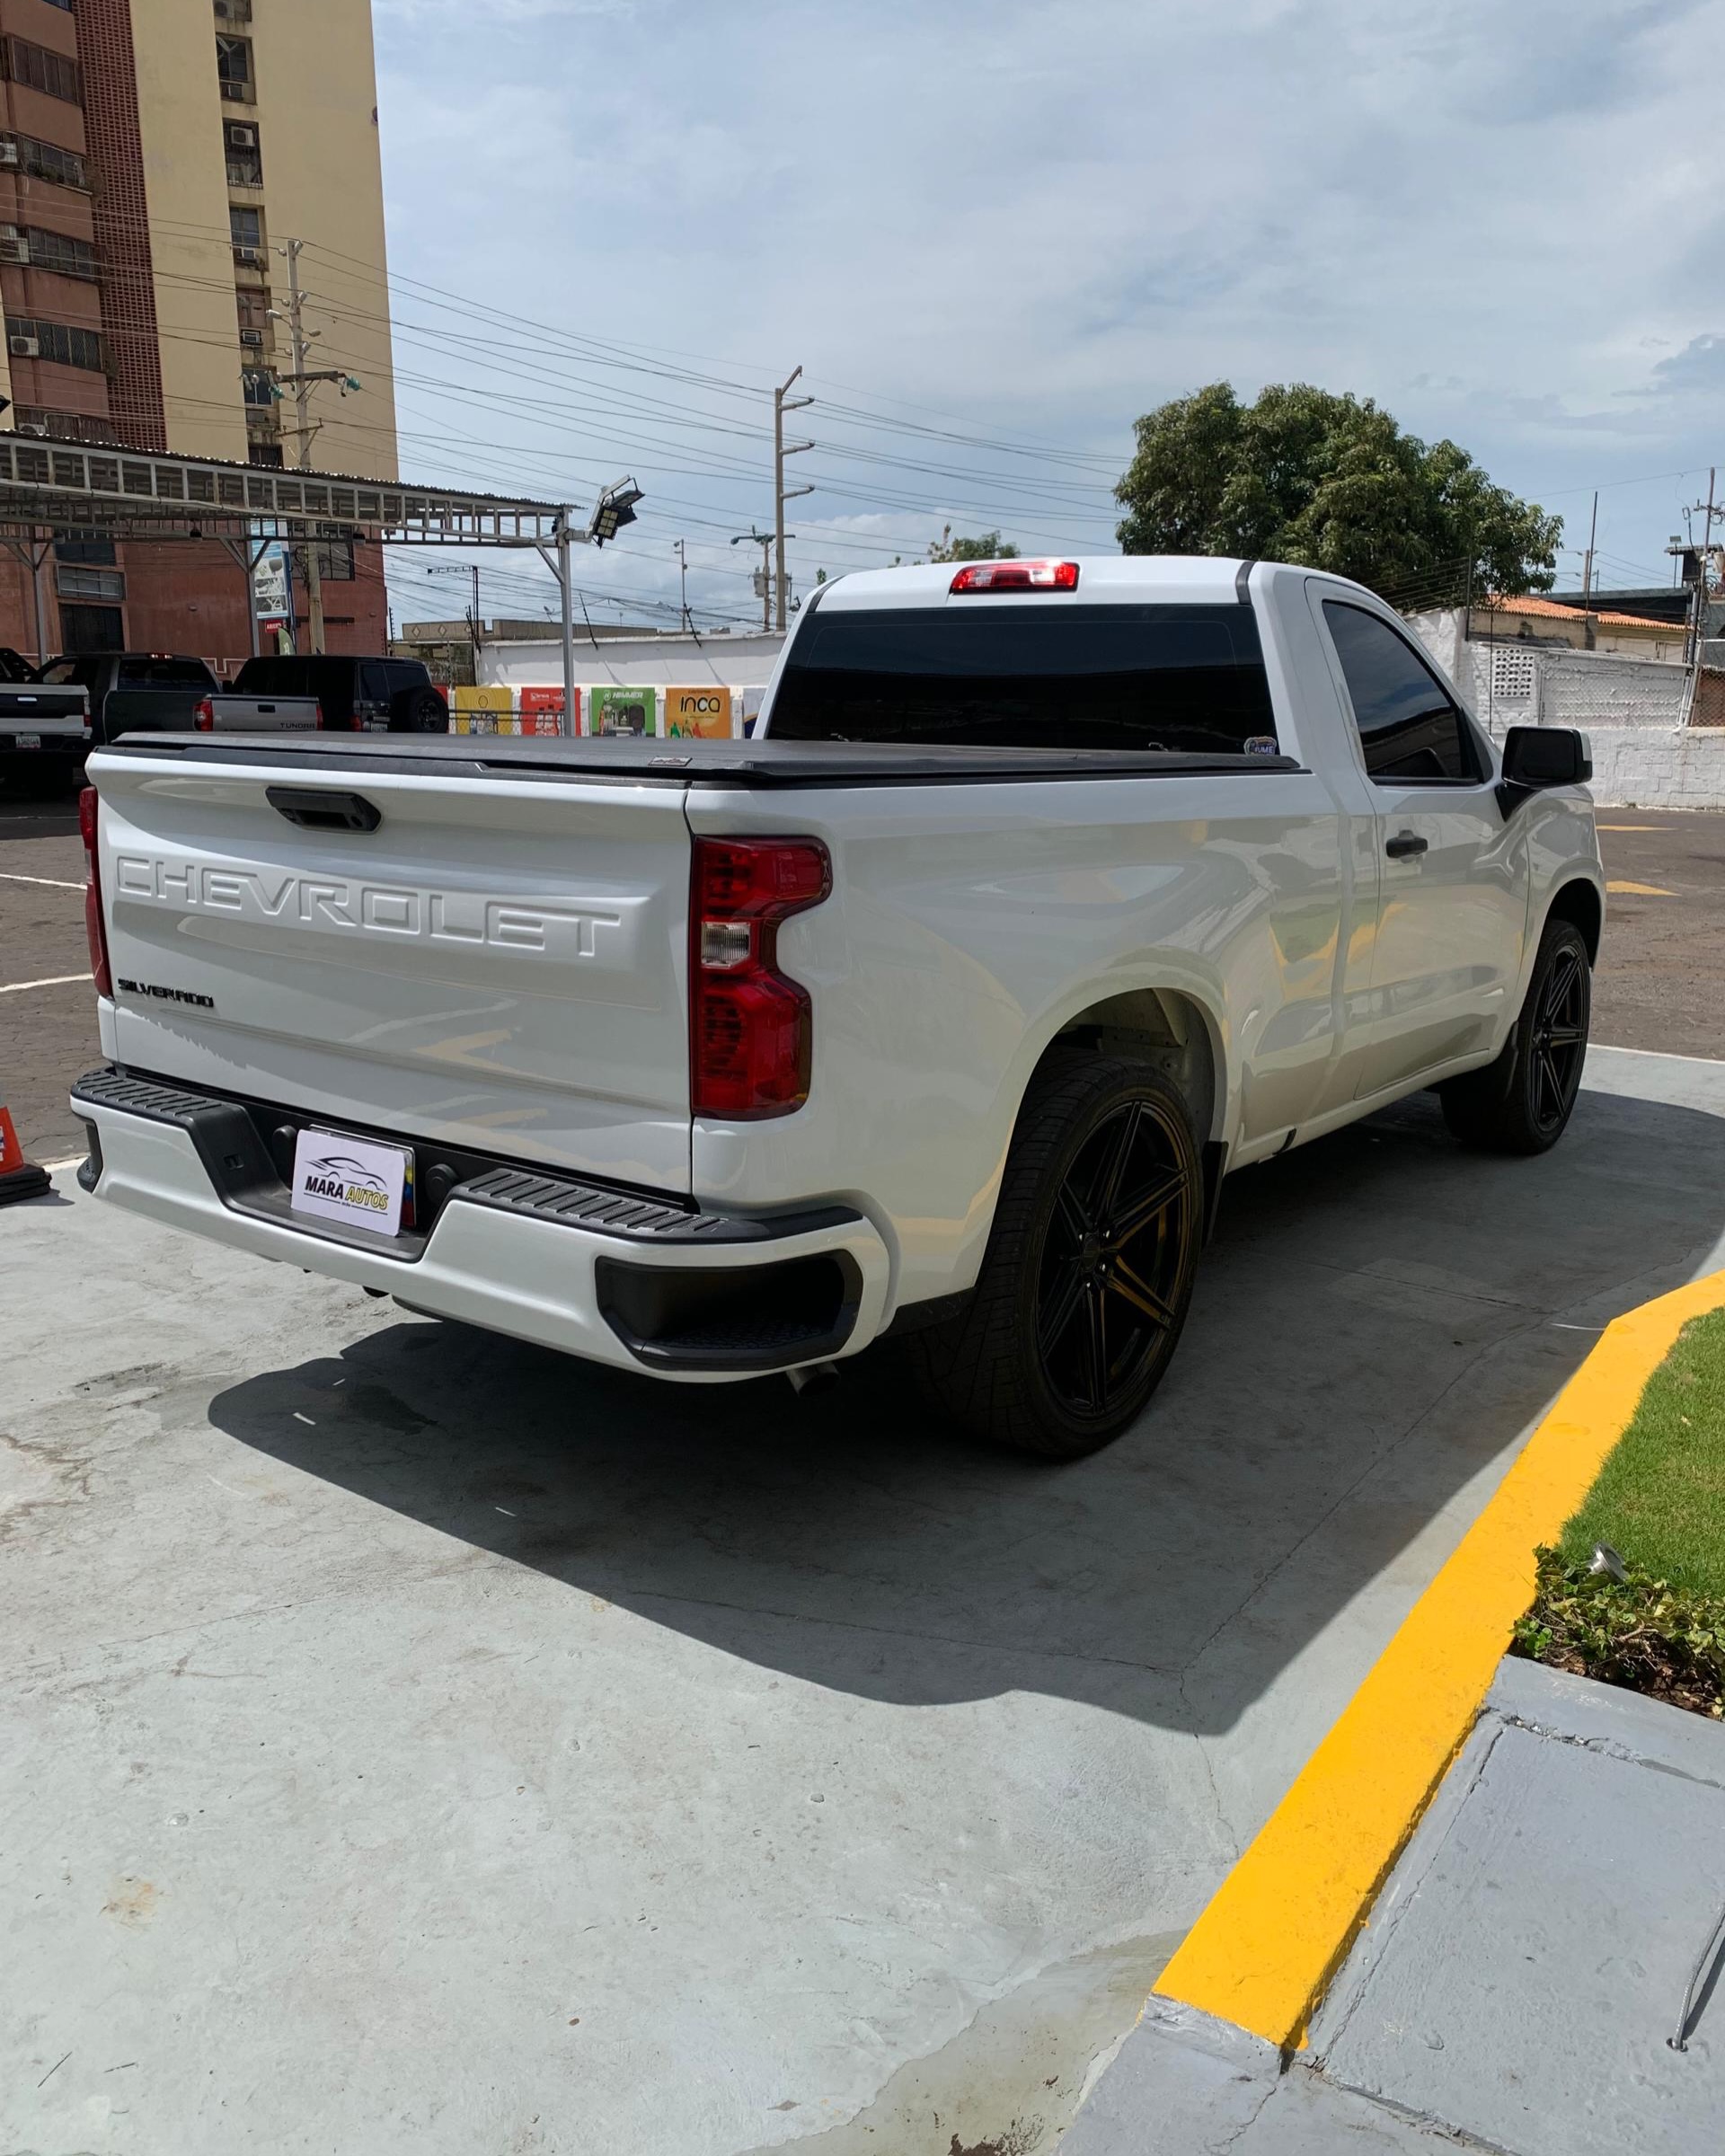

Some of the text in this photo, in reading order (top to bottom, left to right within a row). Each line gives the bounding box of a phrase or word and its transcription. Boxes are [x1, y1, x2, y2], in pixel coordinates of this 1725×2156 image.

[279, 721, 315, 729] TUNDRA
[117, 856, 621, 957] CHEVROLET
[118, 978, 214, 1008] SILVERADO
[305, 1176, 388, 1210] MARA AUTOS
